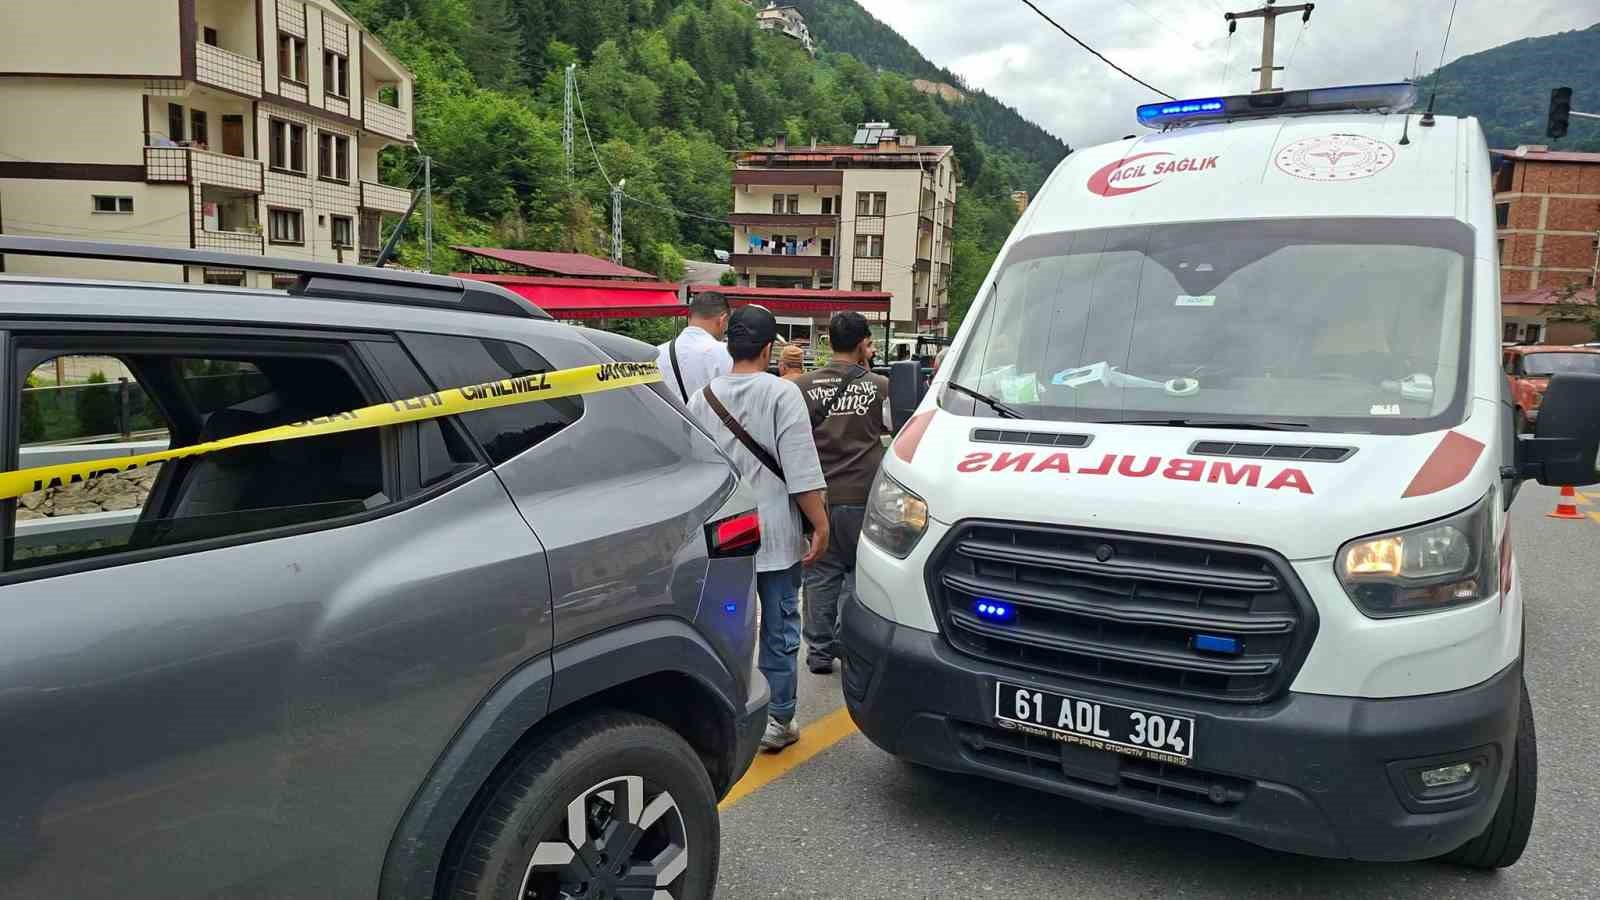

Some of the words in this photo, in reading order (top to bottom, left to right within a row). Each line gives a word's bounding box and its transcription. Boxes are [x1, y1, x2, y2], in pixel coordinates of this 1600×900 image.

[1153, 155, 1219, 174] SAĞLIK
[1015, 689, 1043, 723] 61
[1057, 699, 1110, 737] ADL
[1129, 712, 1185, 752] 304
